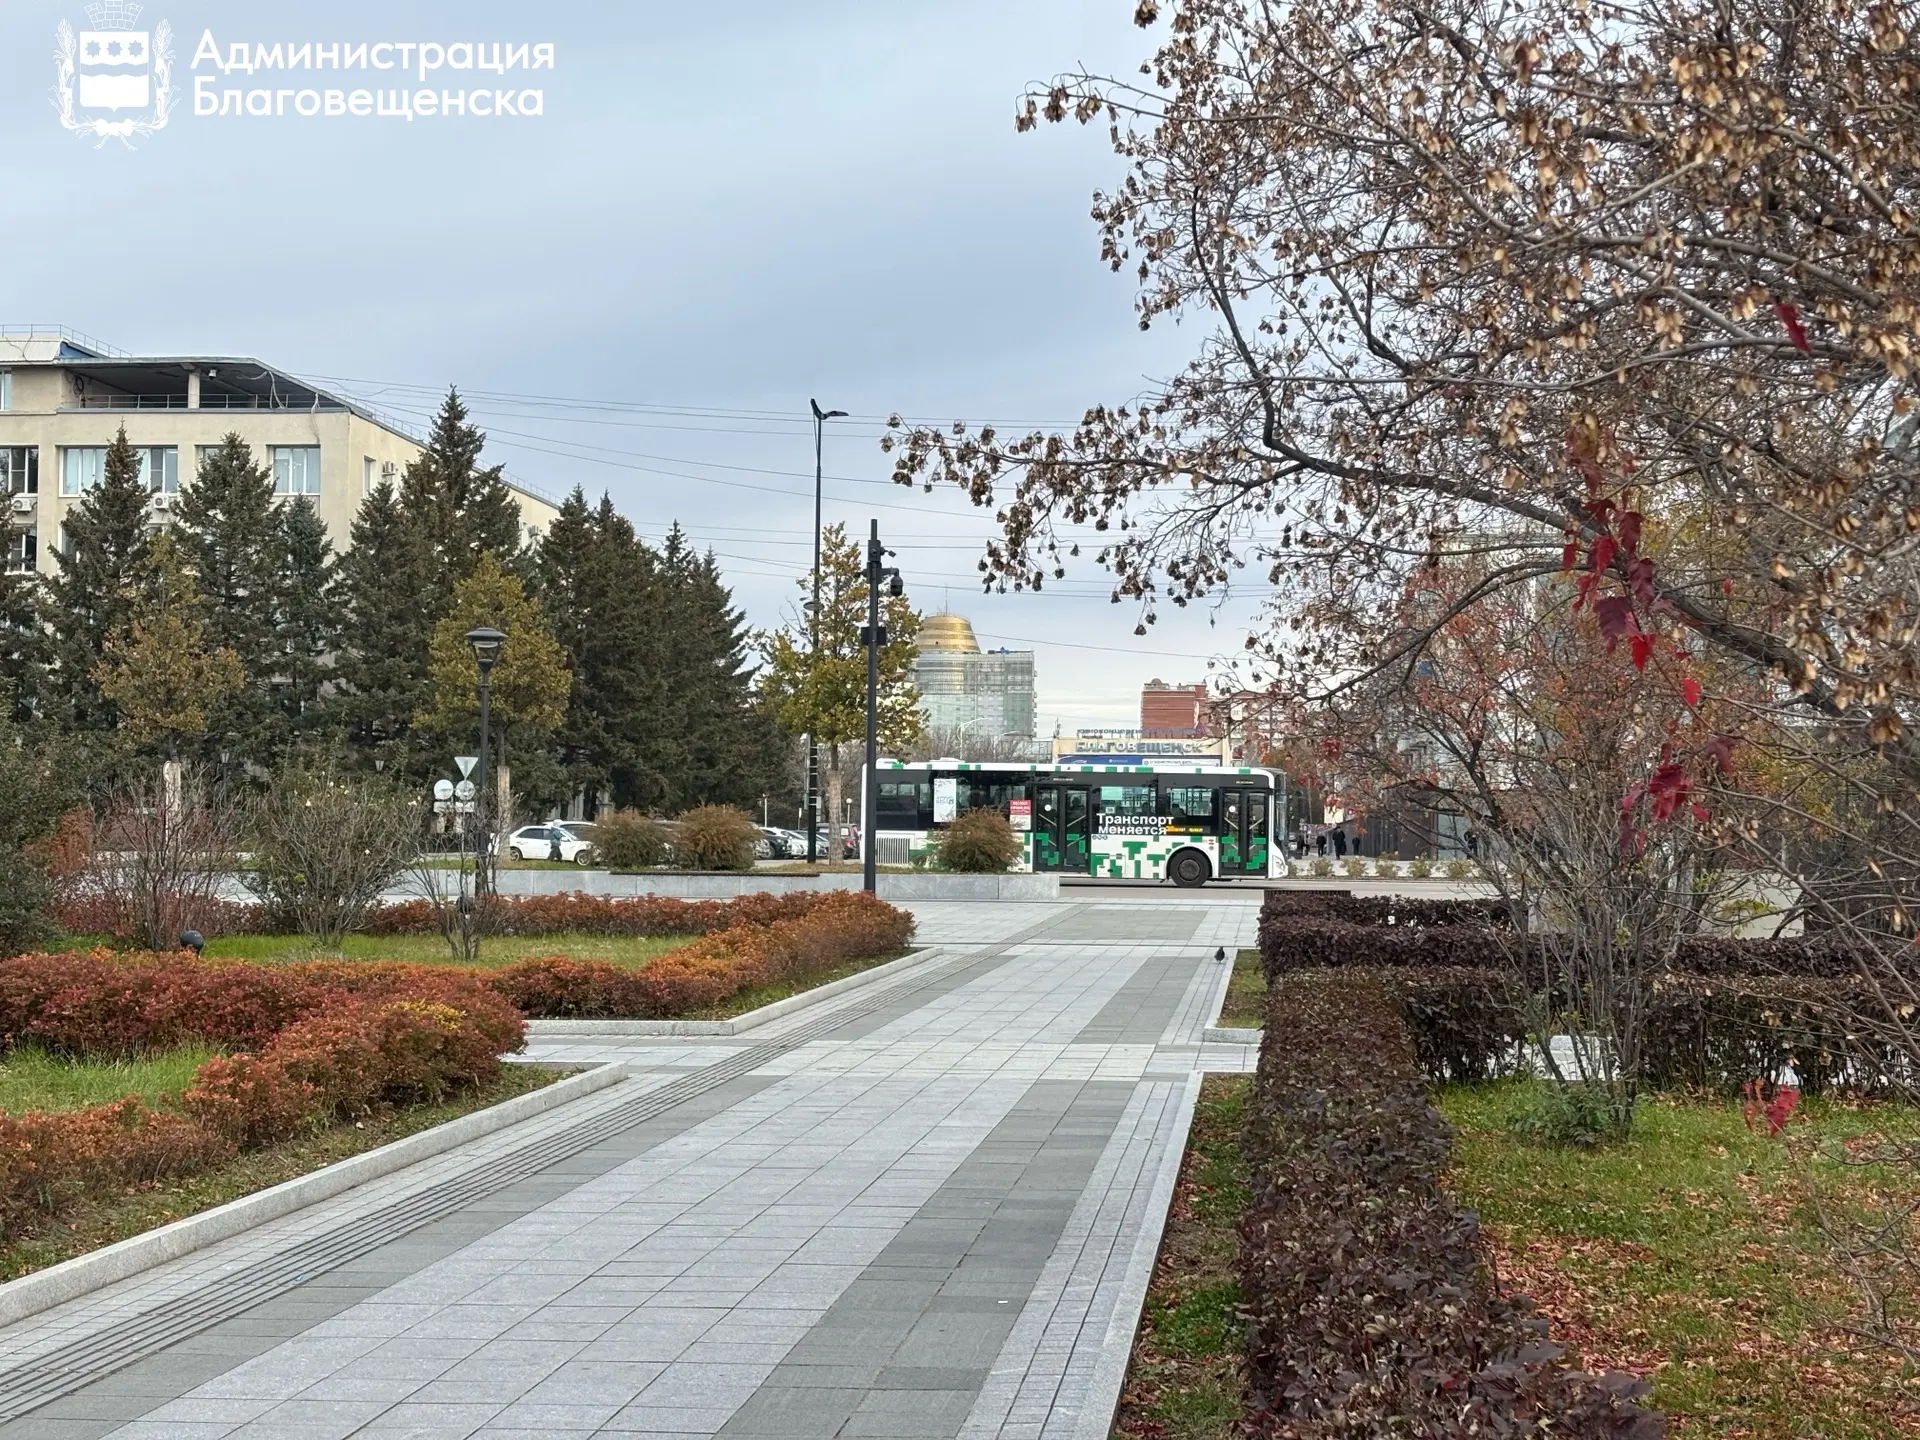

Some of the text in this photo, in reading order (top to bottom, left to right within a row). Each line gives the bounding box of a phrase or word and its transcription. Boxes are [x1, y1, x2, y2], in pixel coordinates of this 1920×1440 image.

[1076, 741, 1203, 755] БЛАГОВЕЩЕНСК
[1096, 813, 1175, 827] Транспорт
[1098, 825, 1167, 835] меняется
